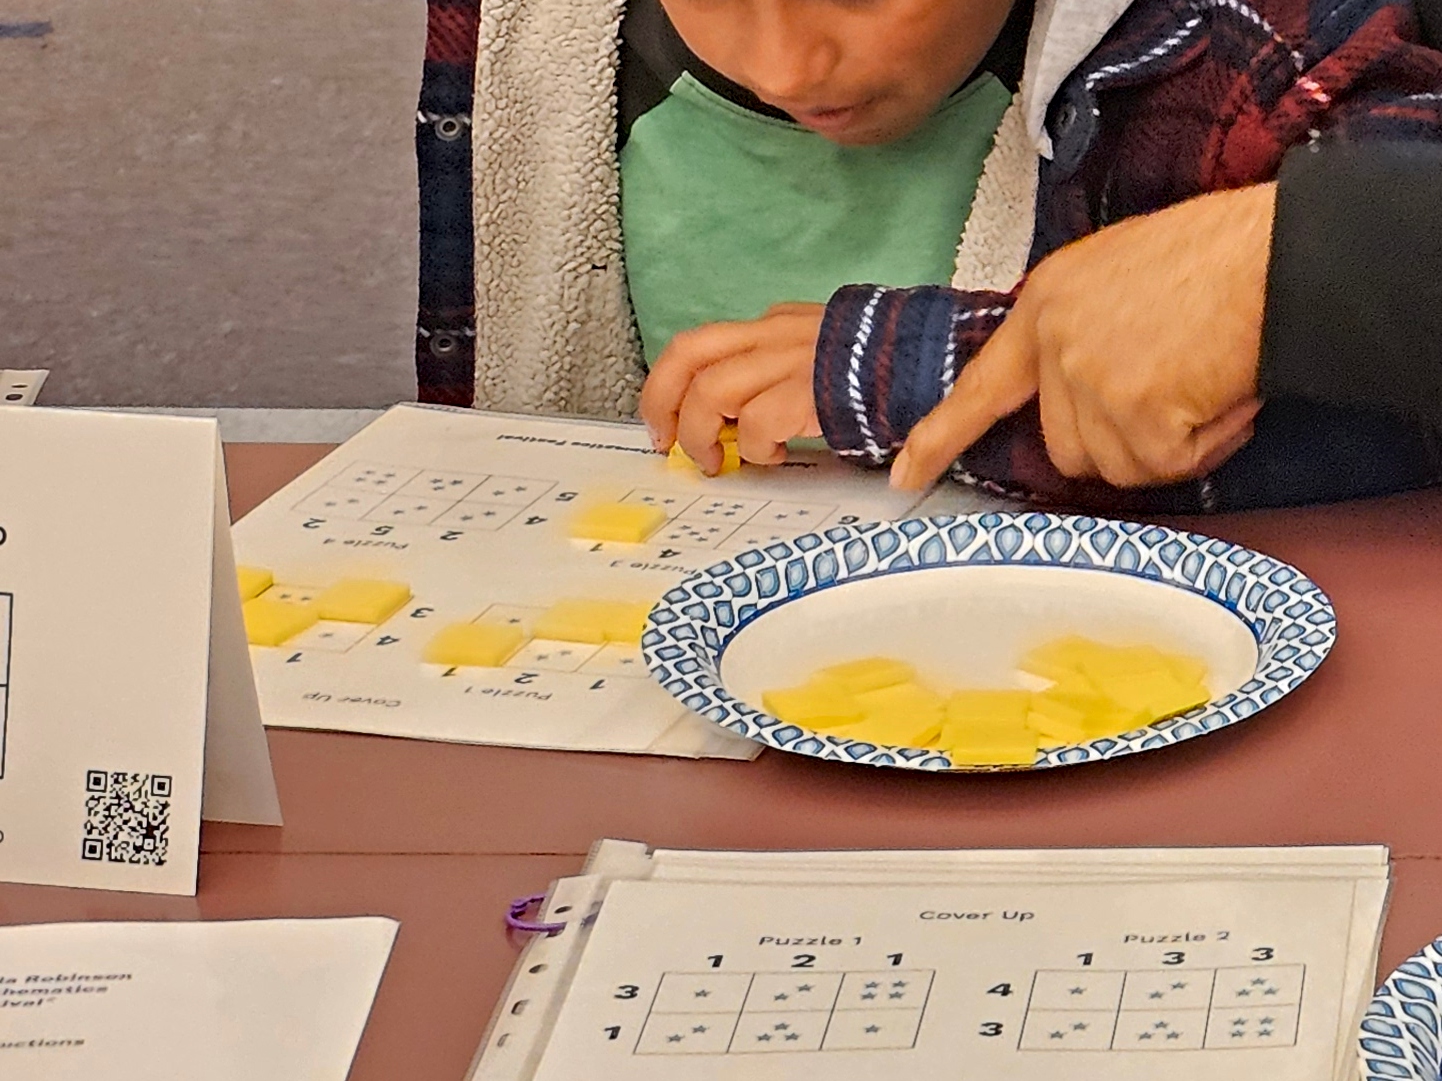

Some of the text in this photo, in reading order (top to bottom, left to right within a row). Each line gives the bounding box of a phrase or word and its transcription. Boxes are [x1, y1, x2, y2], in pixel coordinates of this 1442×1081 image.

[496, 434, 567, 446] Festival
[554, 491, 579, 502] 5
[524, 515, 548, 526] 4
[302, 517, 464, 541] 2 5 2
[343, 539, 409, 550] Puzzle
[589, 542, 681, 559] 4 1
[409, 607, 435, 619] 3
[375, 635, 400, 646] 4
[286, 652, 303, 664] 1
[441, 666, 605, 690] 1 2 1
[303, 692, 402, 708] Cover Up
[464, 686, 553, 701] Puzzle 1
[919, 910, 1035, 922] Cover Up
[758, 935, 862, 946] Puzzle 1
[1123, 931, 1230, 944] Puzzle 2
[707, 952, 903, 968] 1 2 1
[1077, 947, 1274, 966] 1 3 3
[24, 973, 132, 984] Robinson
[613, 984, 640, 1000] 3
[986, 983, 1013, 997] 4
[604, 1025, 622, 1041] 1
[978, 1022, 1004, 1037] 3
